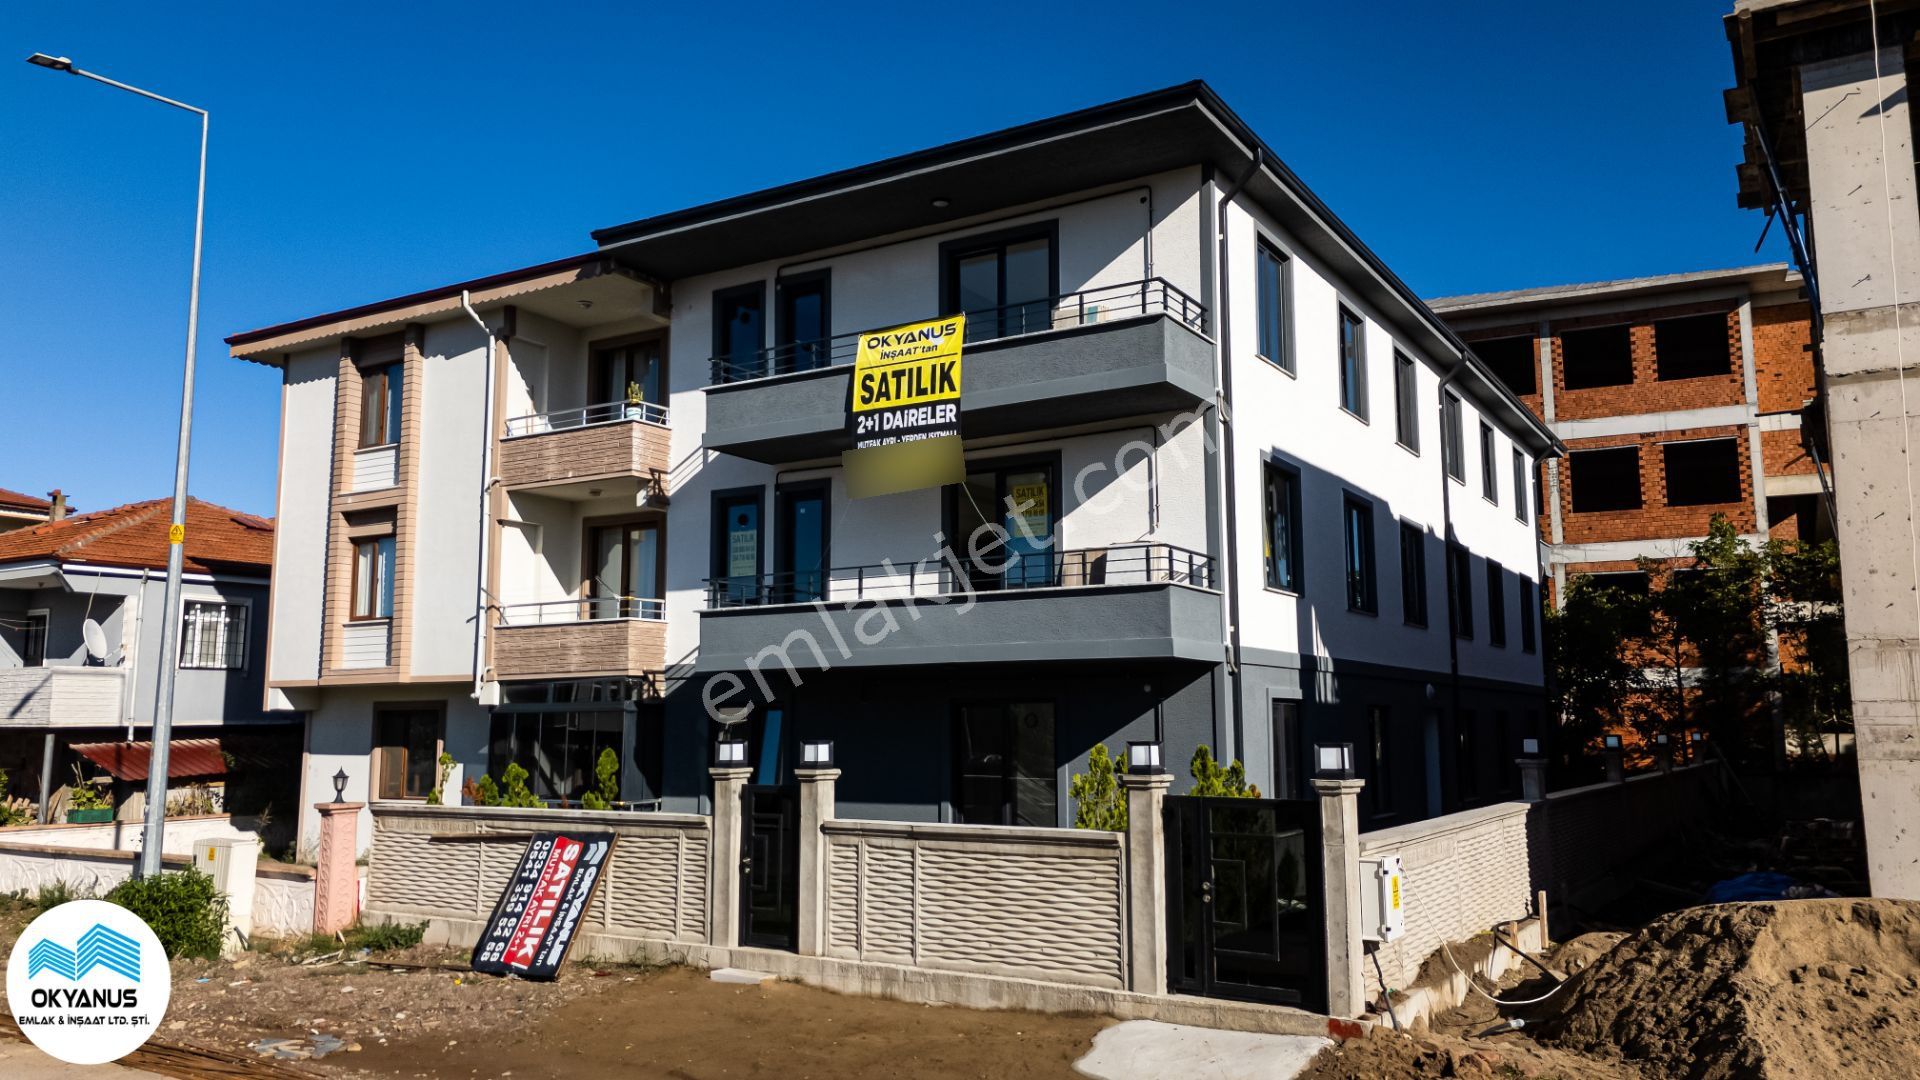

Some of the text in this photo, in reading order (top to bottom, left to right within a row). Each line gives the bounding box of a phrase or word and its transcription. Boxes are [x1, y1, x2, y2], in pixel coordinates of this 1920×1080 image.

[867, 323, 957, 350] OKYANUS
[860, 360, 957, 405] SATILIK
[857, 412, 879, 434] 2+1
[1015, 486, 1044, 498] SATILIK
[521, 840, 542, 877] 0541
[529, 840, 552, 879] 0534
[510, 849, 562, 951] MUTFAK AYRI 2+1
[513, 883, 534, 913] 914
[517, 844, 580, 958] SATILIK
[566, 868, 584, 901] EMLAK
[493, 917, 506, 937] 54
[502, 917, 517, 937] 62
[546, 866, 597, 966] OKYANUS
